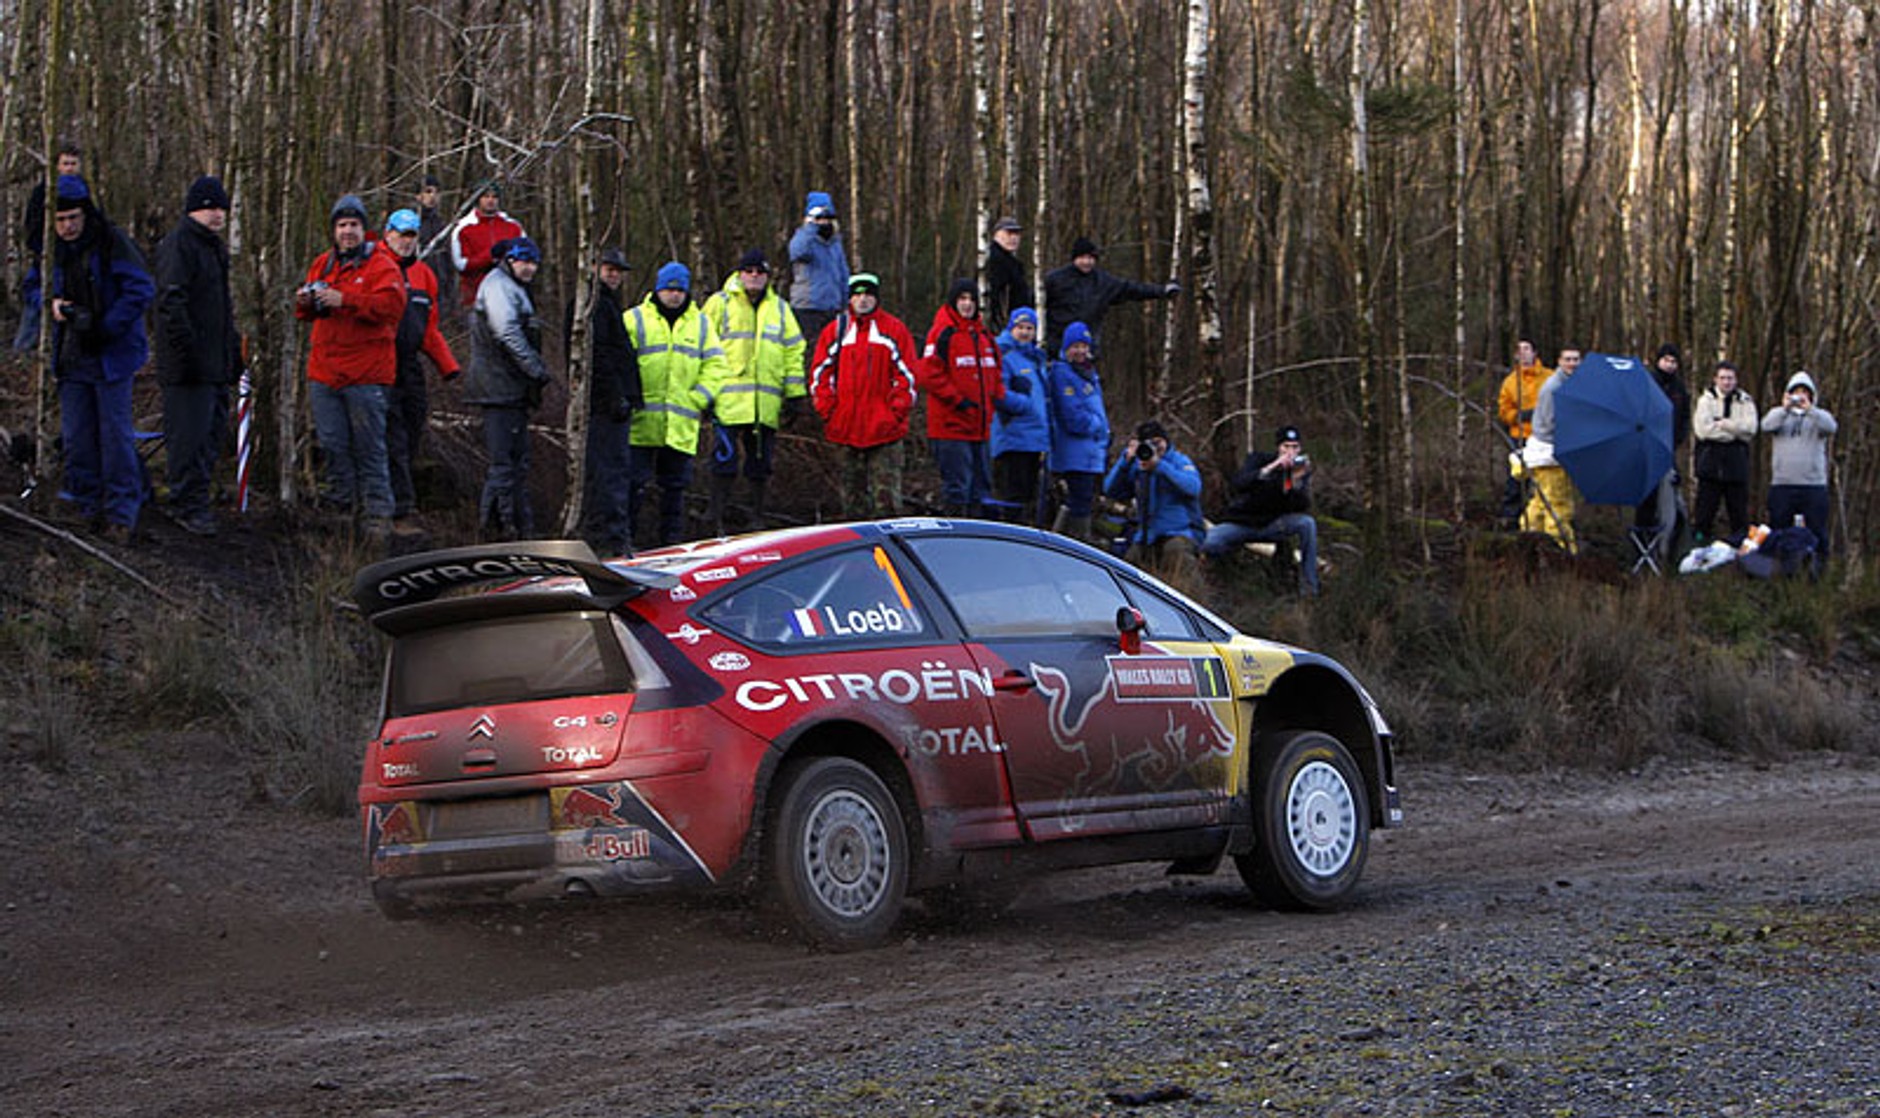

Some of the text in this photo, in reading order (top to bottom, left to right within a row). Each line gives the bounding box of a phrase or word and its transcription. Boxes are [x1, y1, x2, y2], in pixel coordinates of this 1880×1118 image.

[378, 556, 578, 599] CITROËN
[873, 546, 913, 610] 1
[824, 601, 903, 635] Loeb
[735, 661, 996, 711] CITROËN
[1116, 669, 1150, 685] WALES
[1150, 669, 1177, 685] RALLY
[1203, 659, 1217, 697] 1
[553, 715, 587, 729] C4
[542, 746, 603, 763] TOTAL
[901, 725, 1005, 755] TOTAL
[382, 763, 420, 778] TOTAL
[602, 829, 650, 860] Bull
